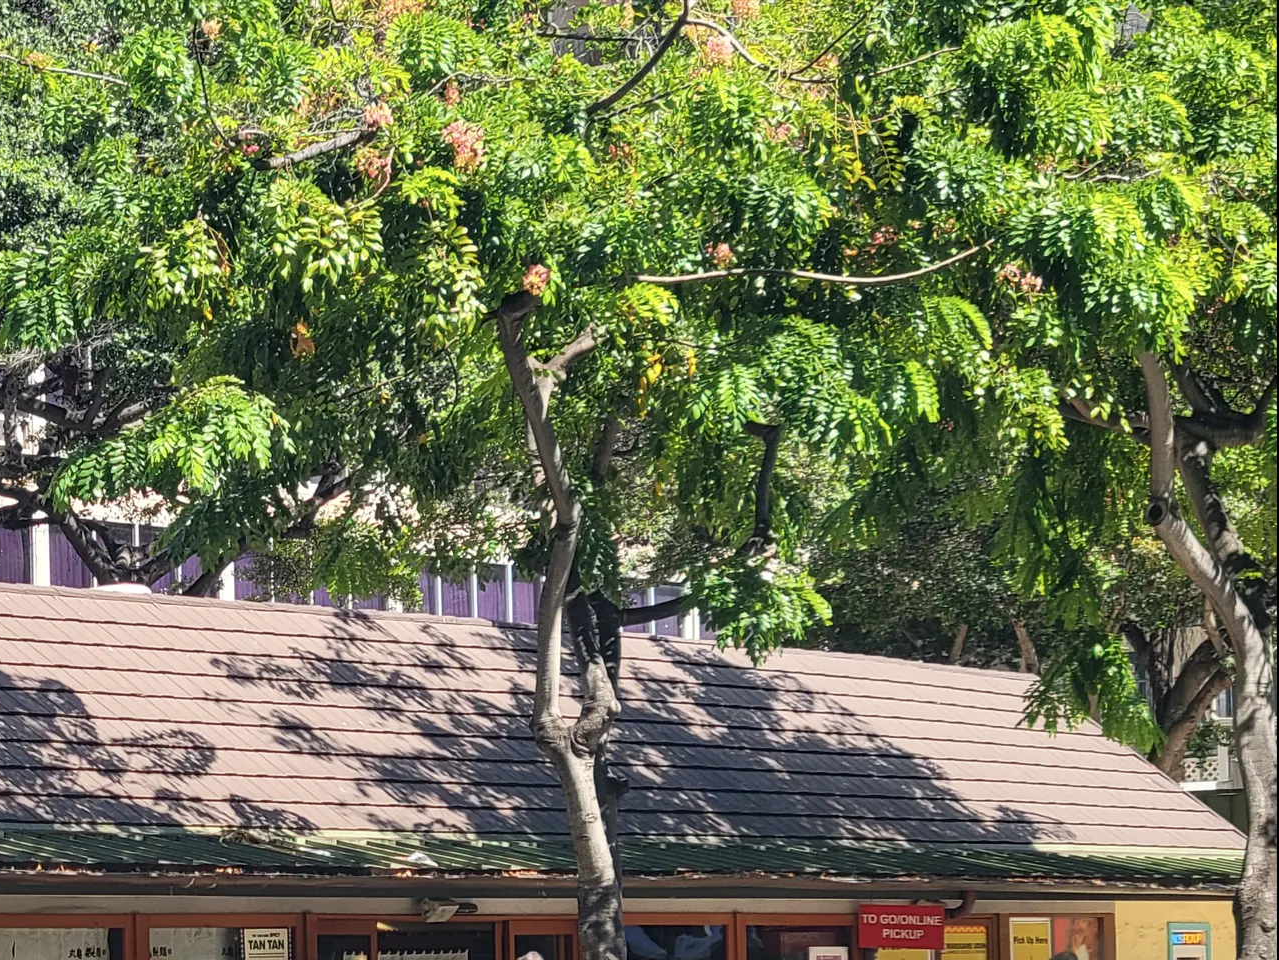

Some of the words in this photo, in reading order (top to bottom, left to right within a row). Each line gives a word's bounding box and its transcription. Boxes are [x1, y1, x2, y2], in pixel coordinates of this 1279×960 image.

[862, 914, 877, 924] TO
[880, 914, 942, 926] GO/ONLINE
[882, 928, 924, 939] PICKUP
[248, 939, 266, 950] TAN
[267, 939, 285, 950] TAN
